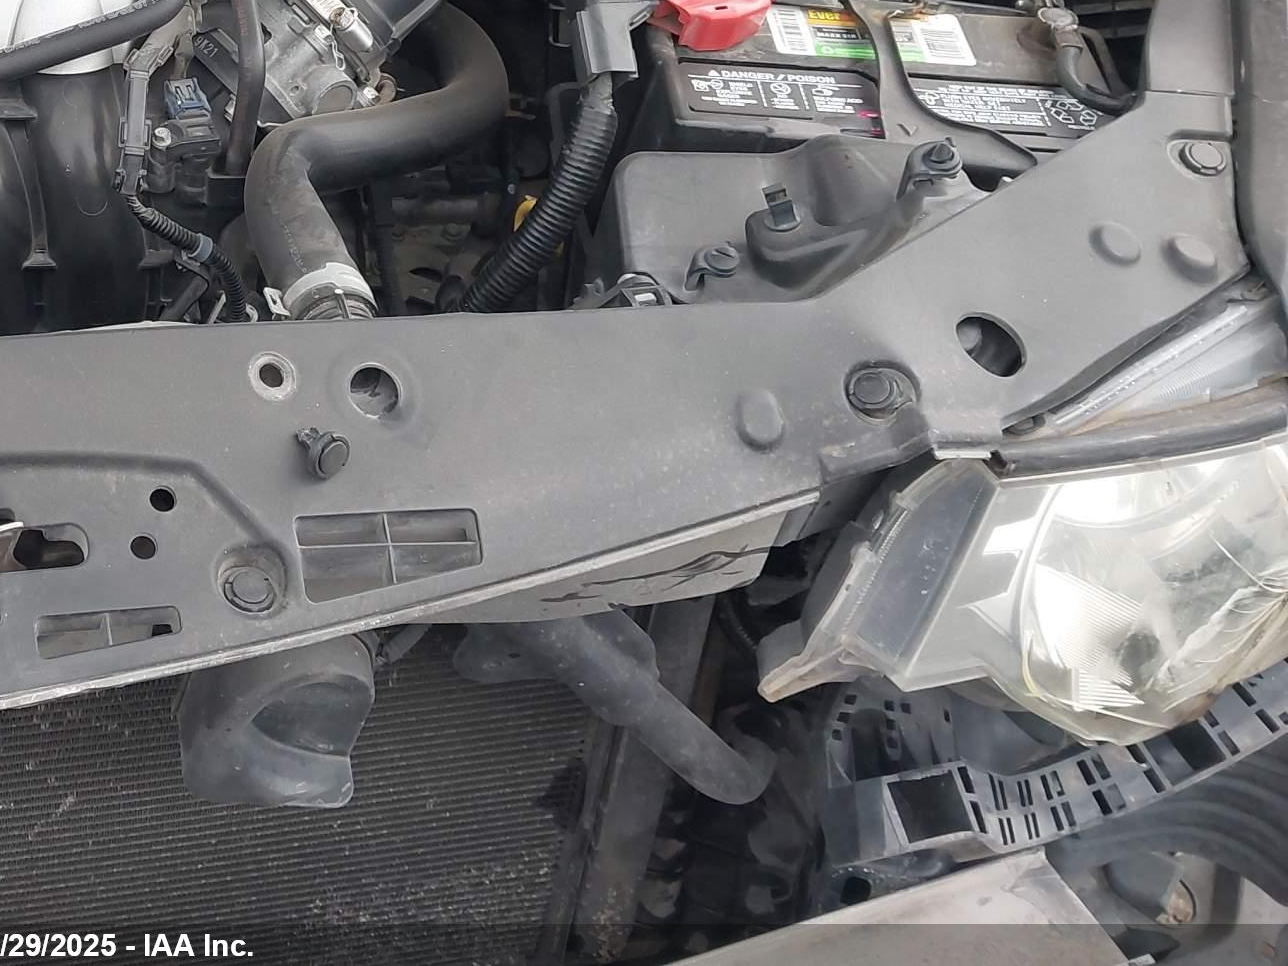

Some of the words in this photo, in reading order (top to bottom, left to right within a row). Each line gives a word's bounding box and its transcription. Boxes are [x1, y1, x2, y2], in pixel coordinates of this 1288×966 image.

[194, 35, 219, 58] 9K21
[720, 70, 775, 81] DANGER
[787, 74, 836, 84] POISON
